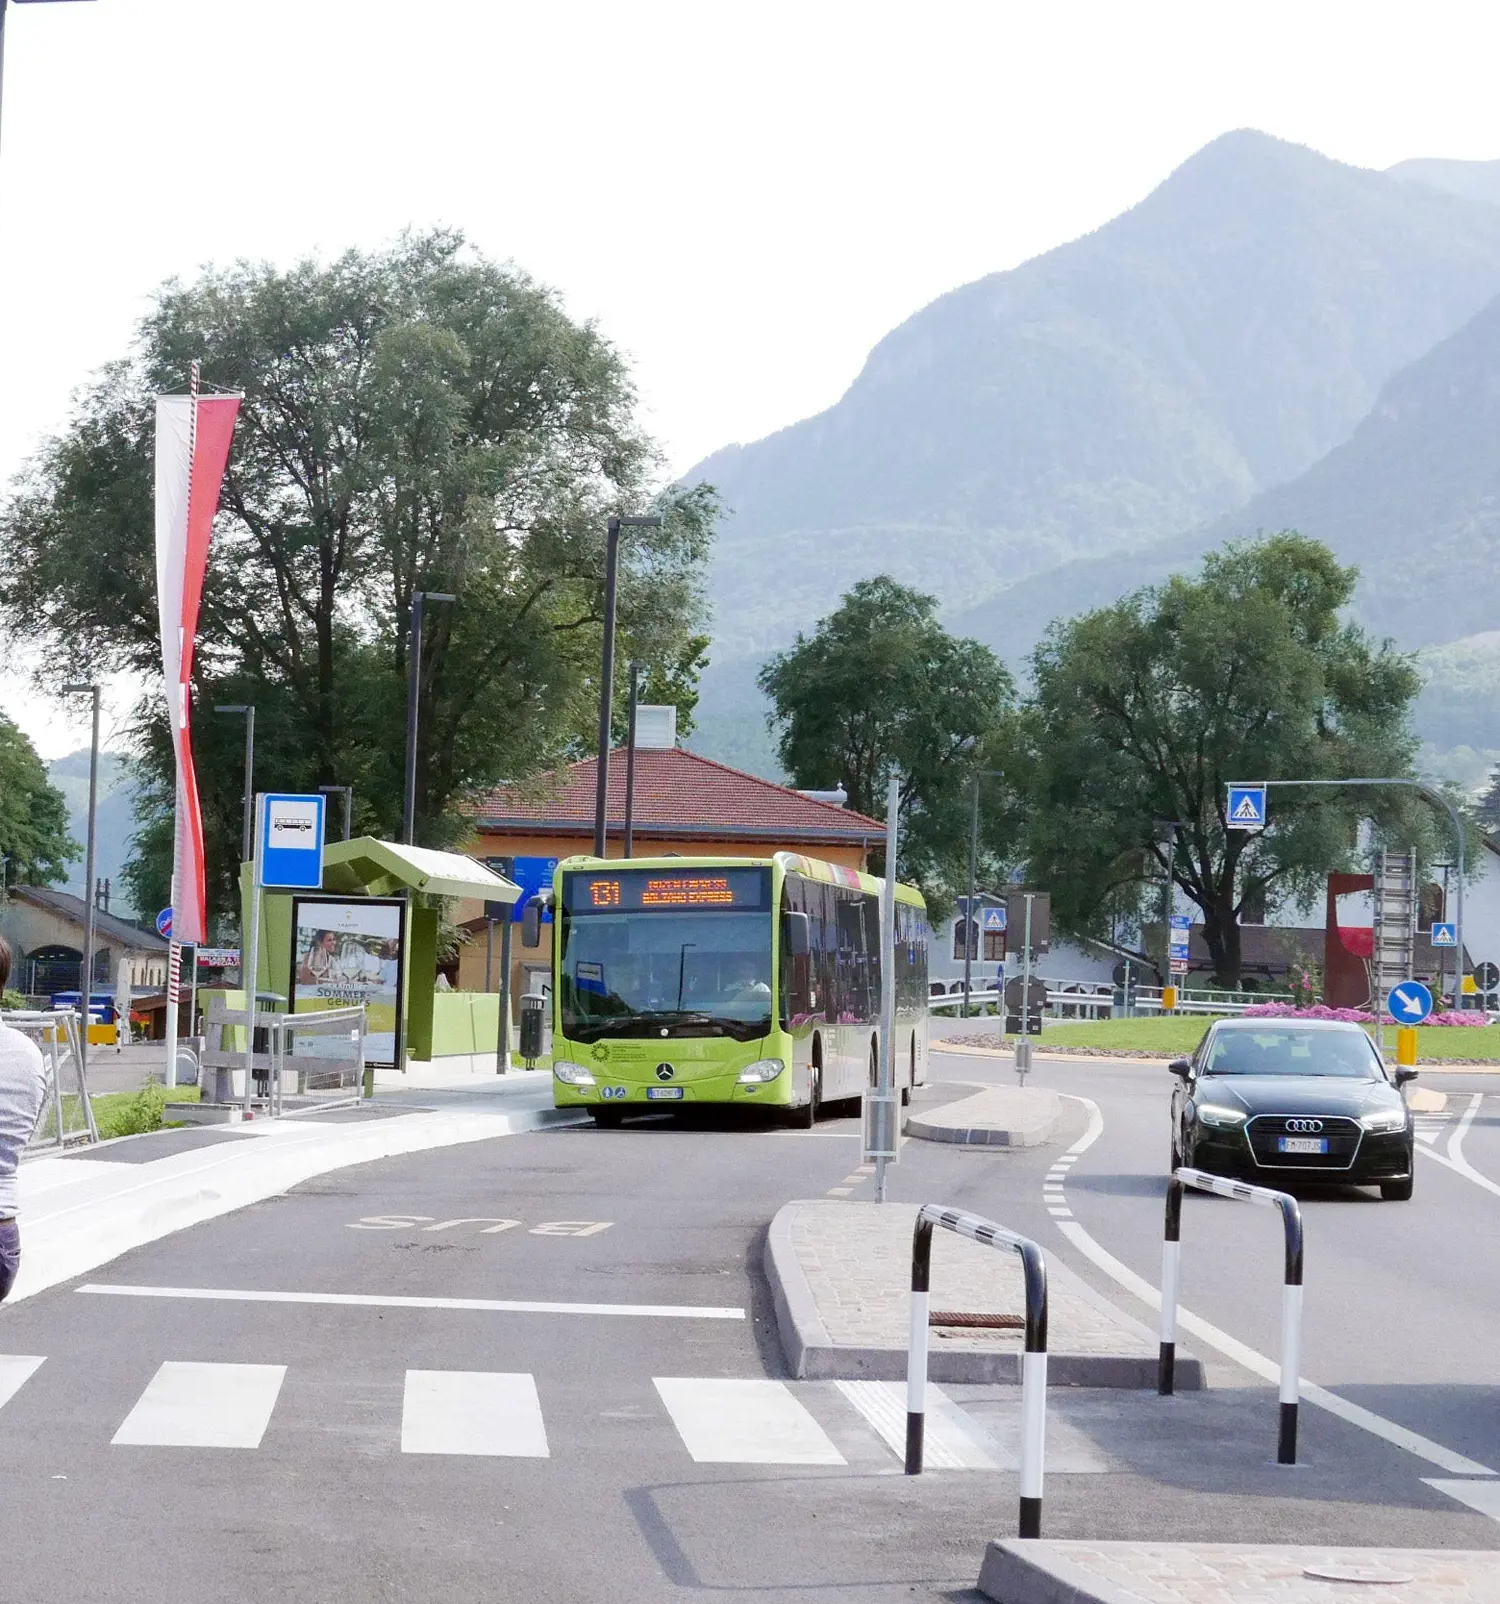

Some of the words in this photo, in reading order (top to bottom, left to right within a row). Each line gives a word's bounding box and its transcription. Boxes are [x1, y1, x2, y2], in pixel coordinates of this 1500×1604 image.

[590, 880, 620, 905] 131
[642, 892, 687, 904] BOLZANO
[688, 891, 733, 903] EXPRESS
[345, 1215, 616, 1236] BUS
